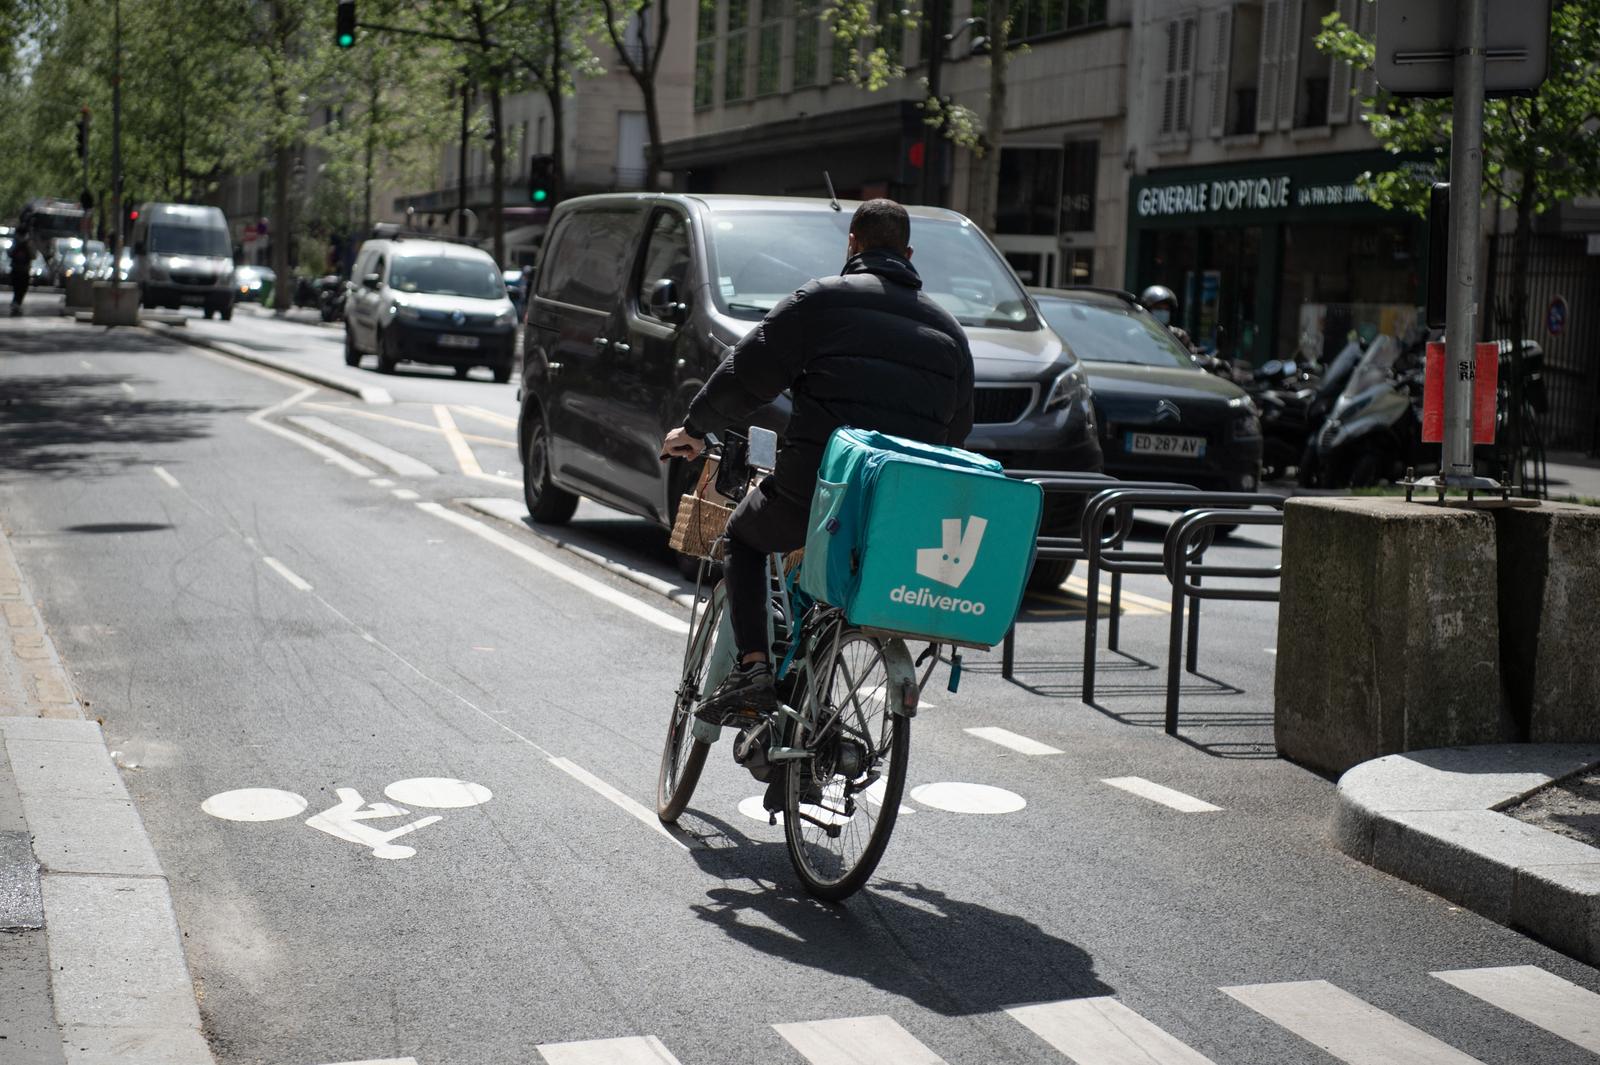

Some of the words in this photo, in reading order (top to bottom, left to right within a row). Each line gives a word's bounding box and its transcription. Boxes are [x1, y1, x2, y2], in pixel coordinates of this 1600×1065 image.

[1137, 182, 1208, 216] GENERALE
[1211, 176, 1291, 211] D'OPTIQUE
[1135, 435, 1152, 450] ED
[1155, 436, 1179, 452] 287
[1182, 438, 1198, 454] AV
[889, 584, 986, 616] deliveroo
